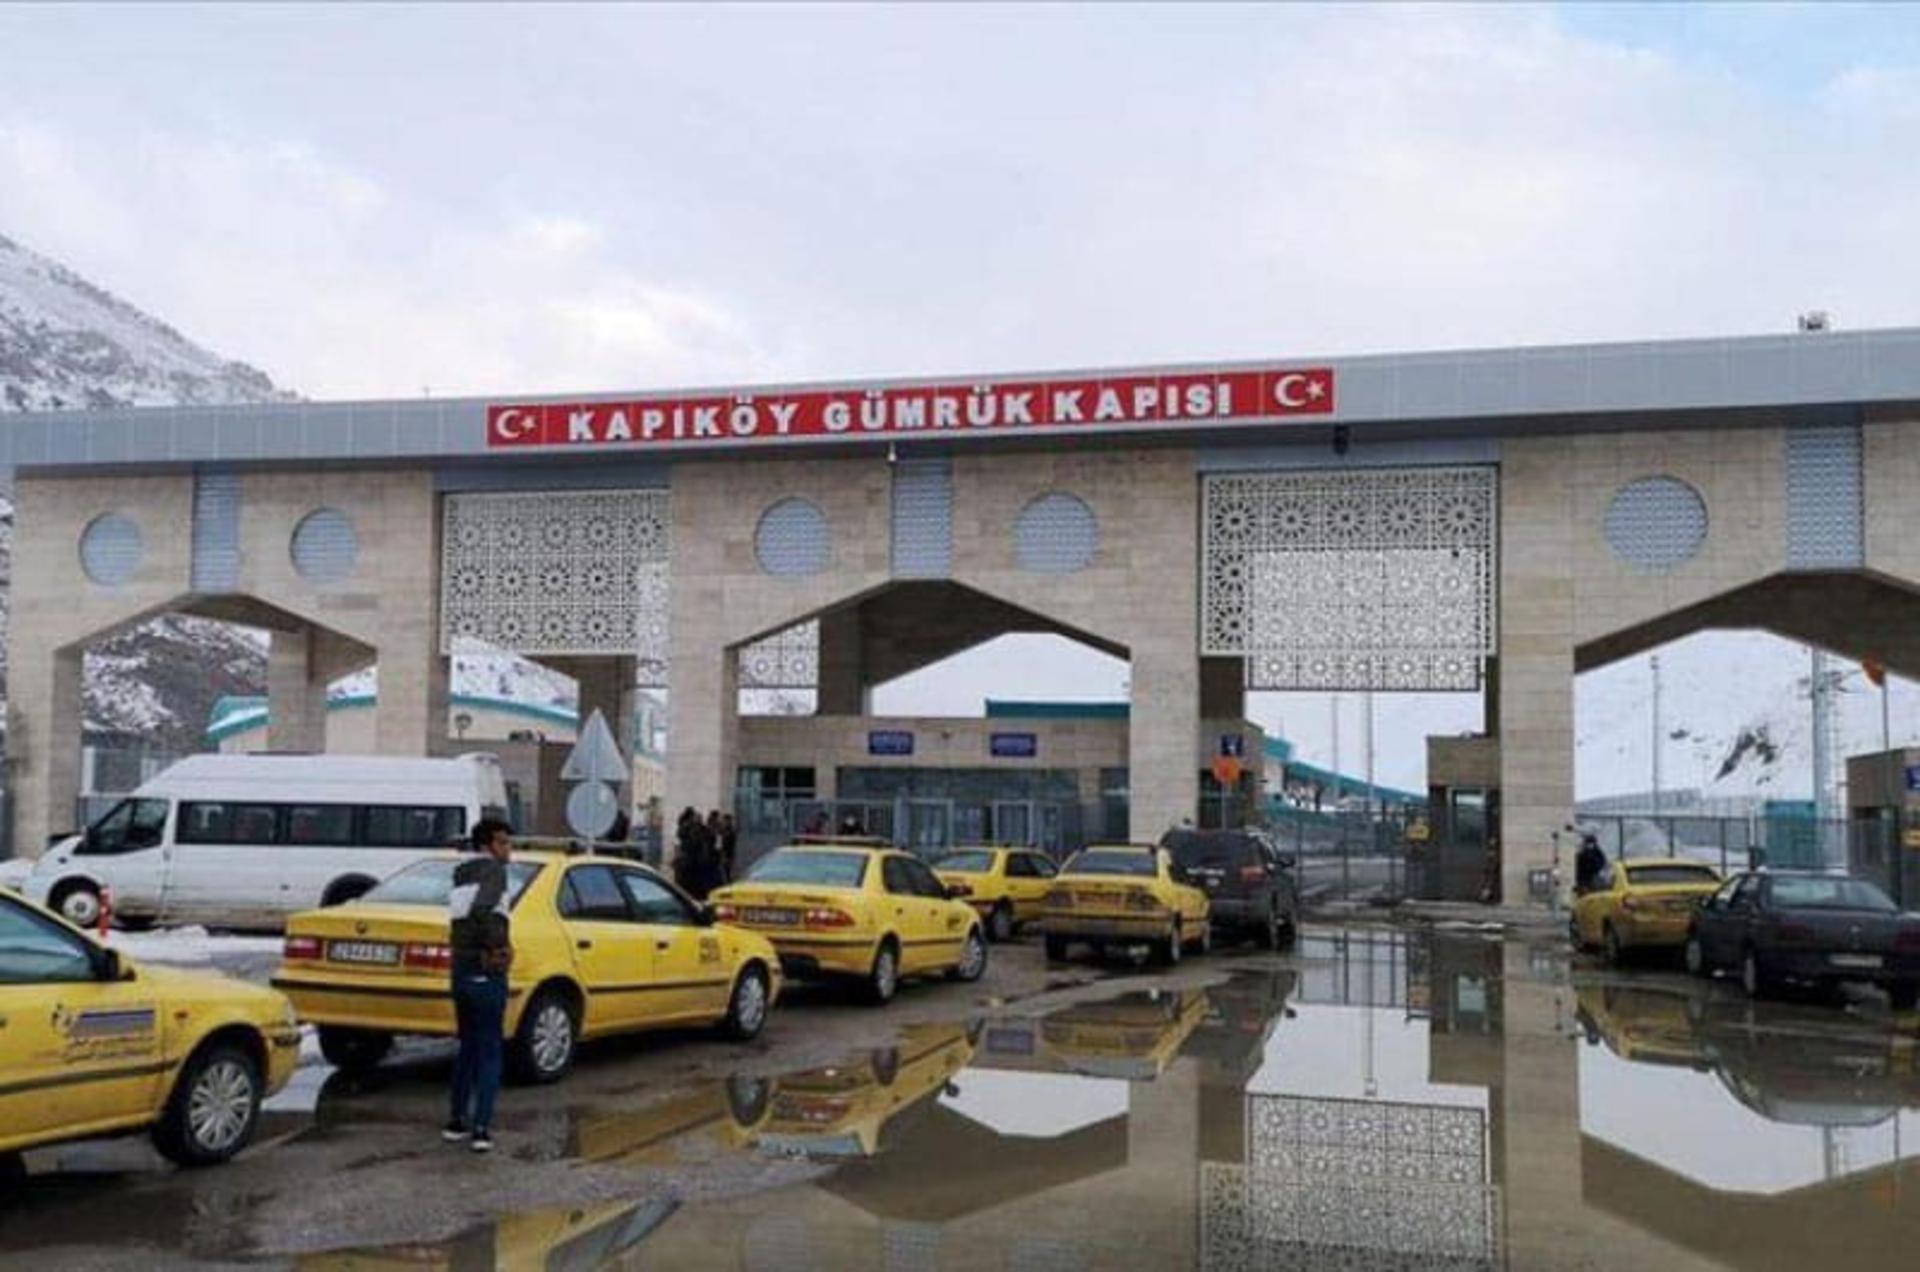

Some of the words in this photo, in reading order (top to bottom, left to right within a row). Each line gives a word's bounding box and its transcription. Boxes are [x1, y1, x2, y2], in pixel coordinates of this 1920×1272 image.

[569, 396, 799, 441] KAPIKÖY
[823, 386, 1032, 431] GÜMRÜK
[1053, 382, 1231, 421] KAPISI
